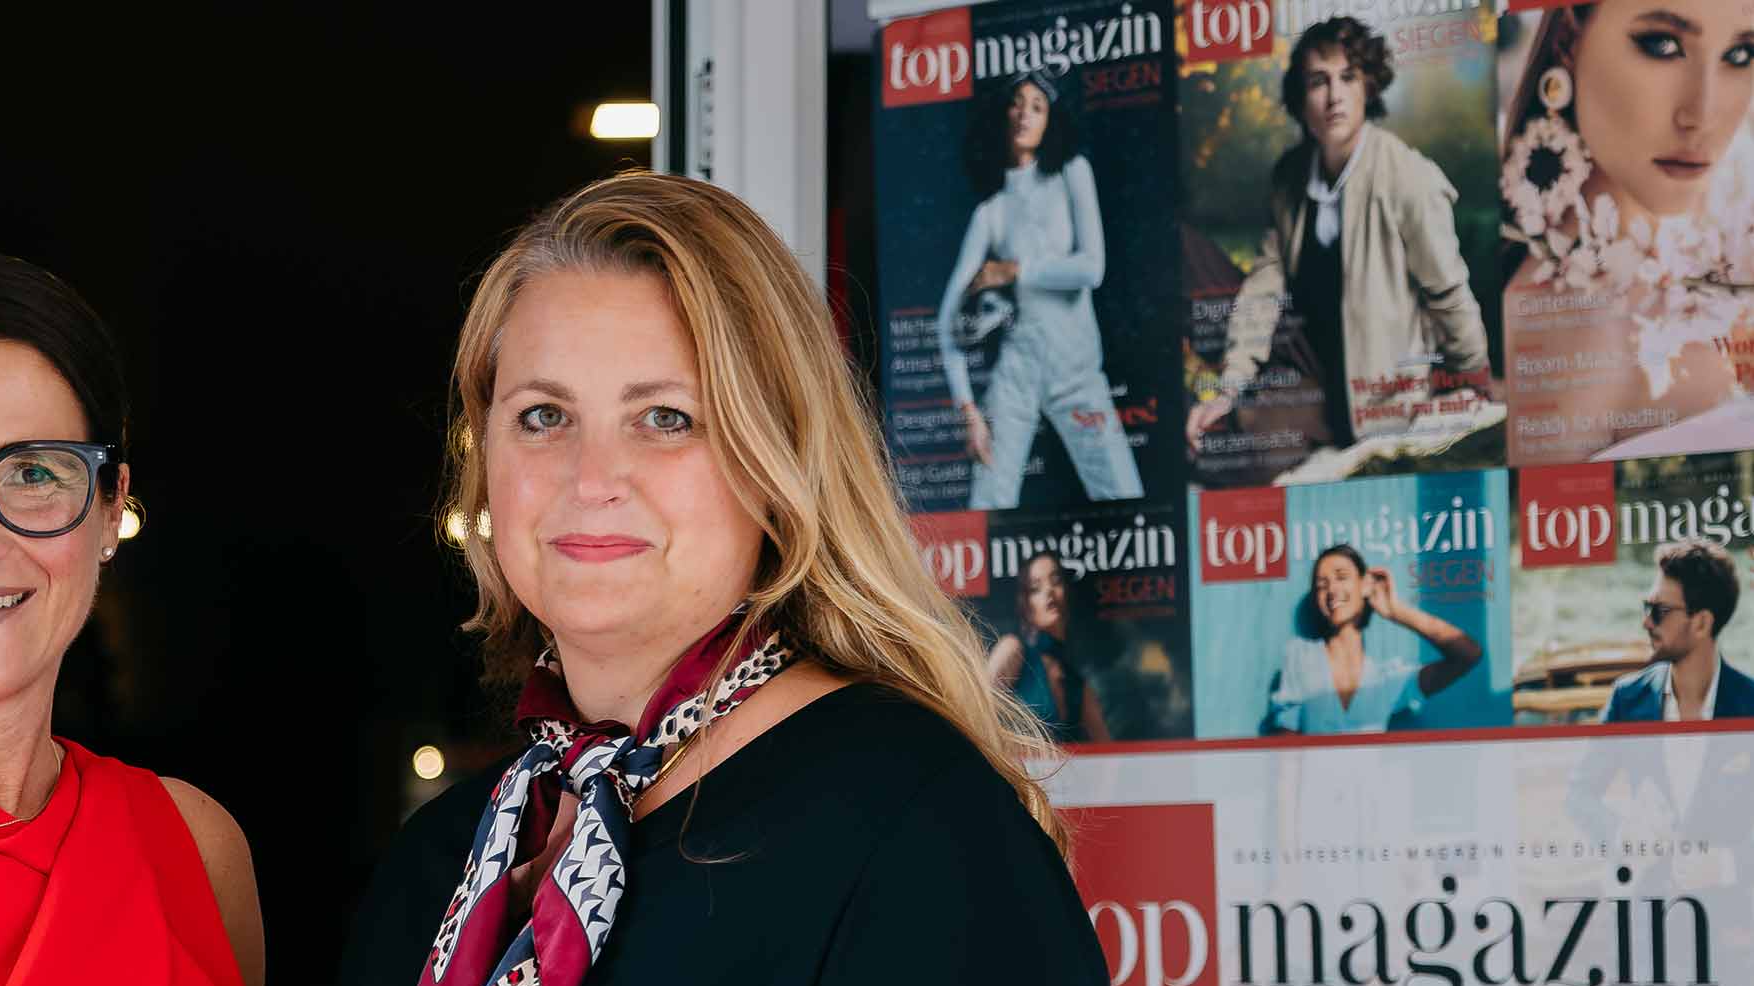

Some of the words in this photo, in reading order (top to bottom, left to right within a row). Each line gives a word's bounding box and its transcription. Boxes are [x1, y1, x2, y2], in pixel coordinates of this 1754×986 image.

[889, 40, 970, 94] top
[975, 3, 1162, 76] magazin
[1192, 0, 1270, 50] top
[1206, 517, 1286, 574] top
[1294, 496, 1495, 562] magazin
[1526, 500, 1611, 558] top
[926, 535, 987, 590] op
[1096, 575, 1176, 600] SIEGEN
[1408, 559, 1495, 588] SIEGEN
